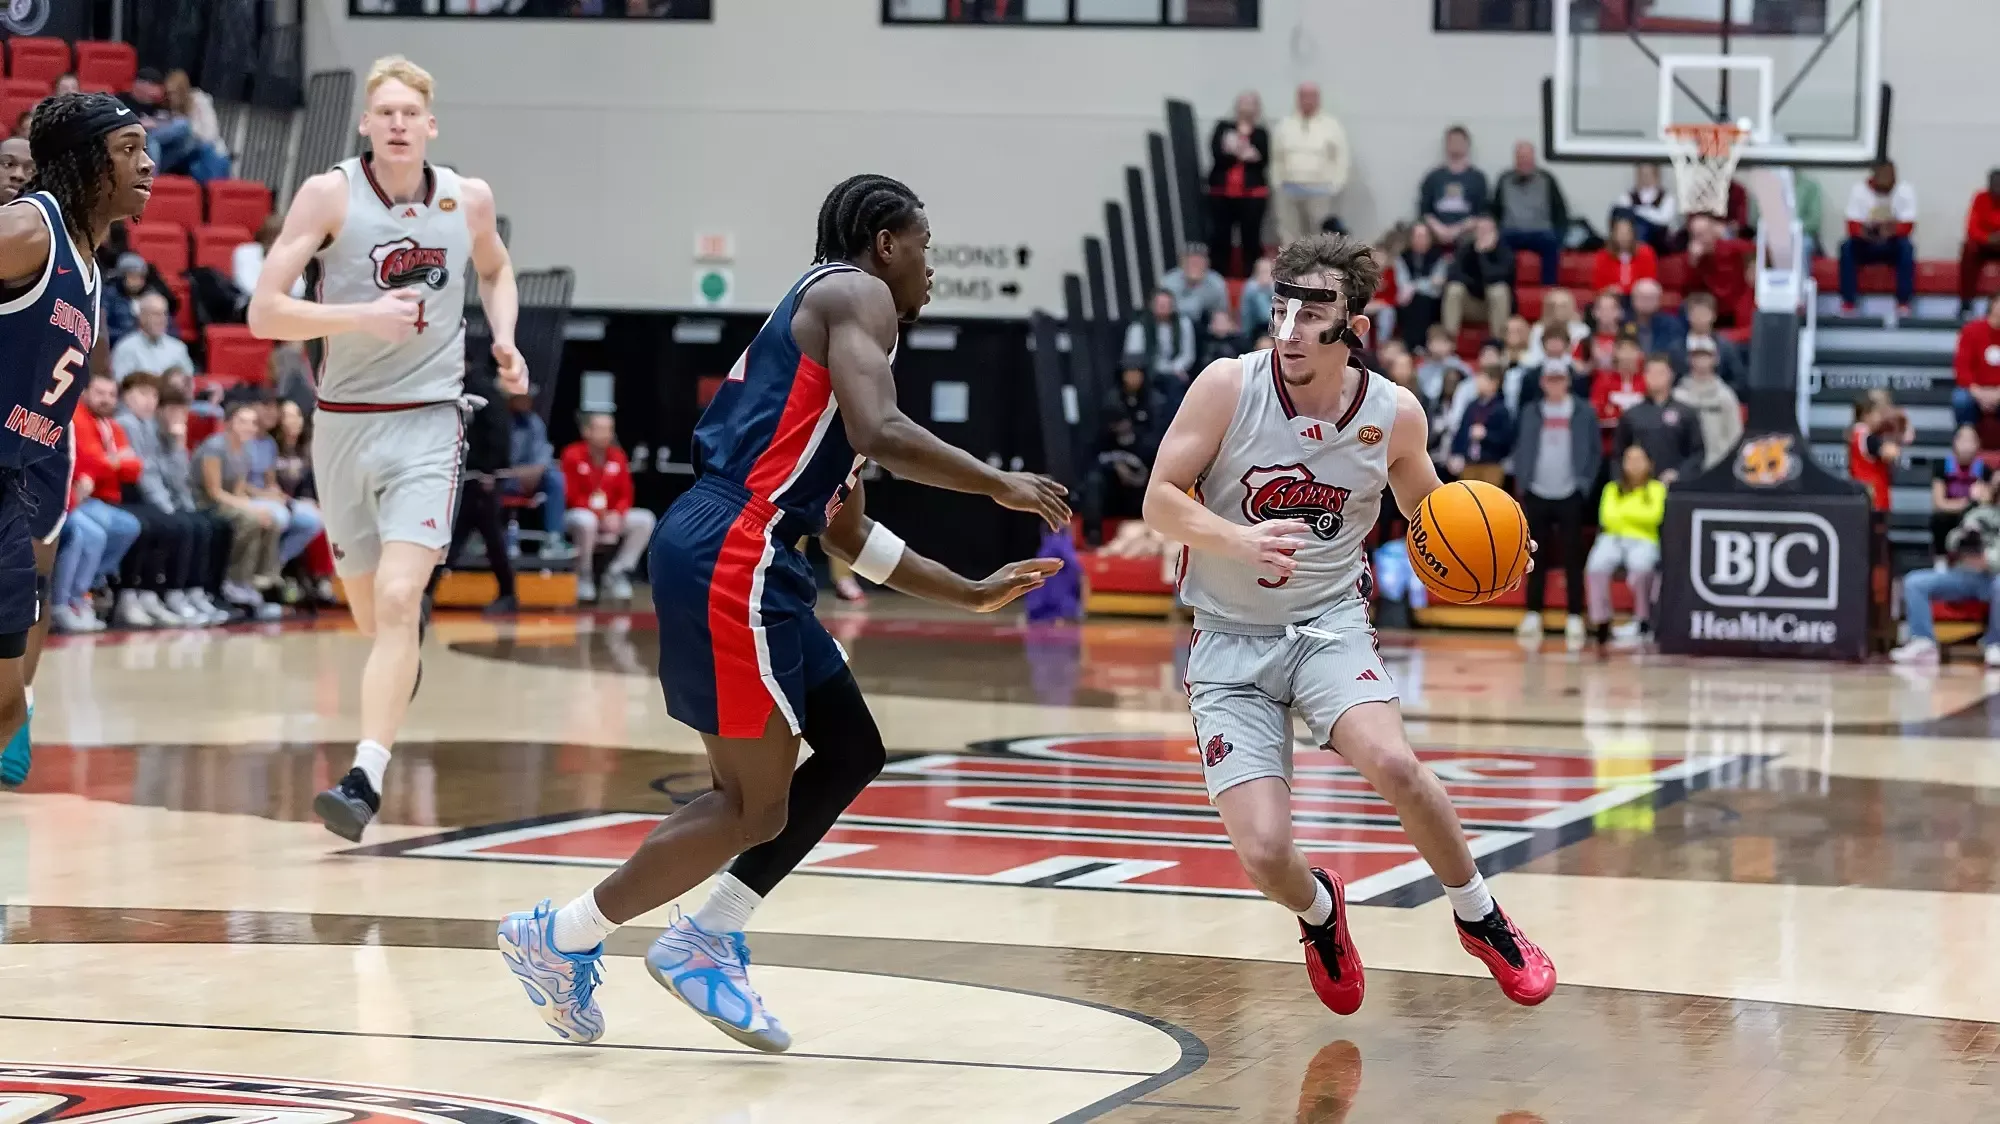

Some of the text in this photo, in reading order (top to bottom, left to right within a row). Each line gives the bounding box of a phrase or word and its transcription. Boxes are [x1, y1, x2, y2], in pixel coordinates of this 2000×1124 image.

[41, 346, 84, 405] 5
[1362, 430, 1379, 440] OVC
[1251, 476, 1352, 524] 66ERS
[1411, 505, 1449, 580] Wilson
[1709, 530, 1820, 596] BJC
[1690, 610, 1838, 644] HealthCare
